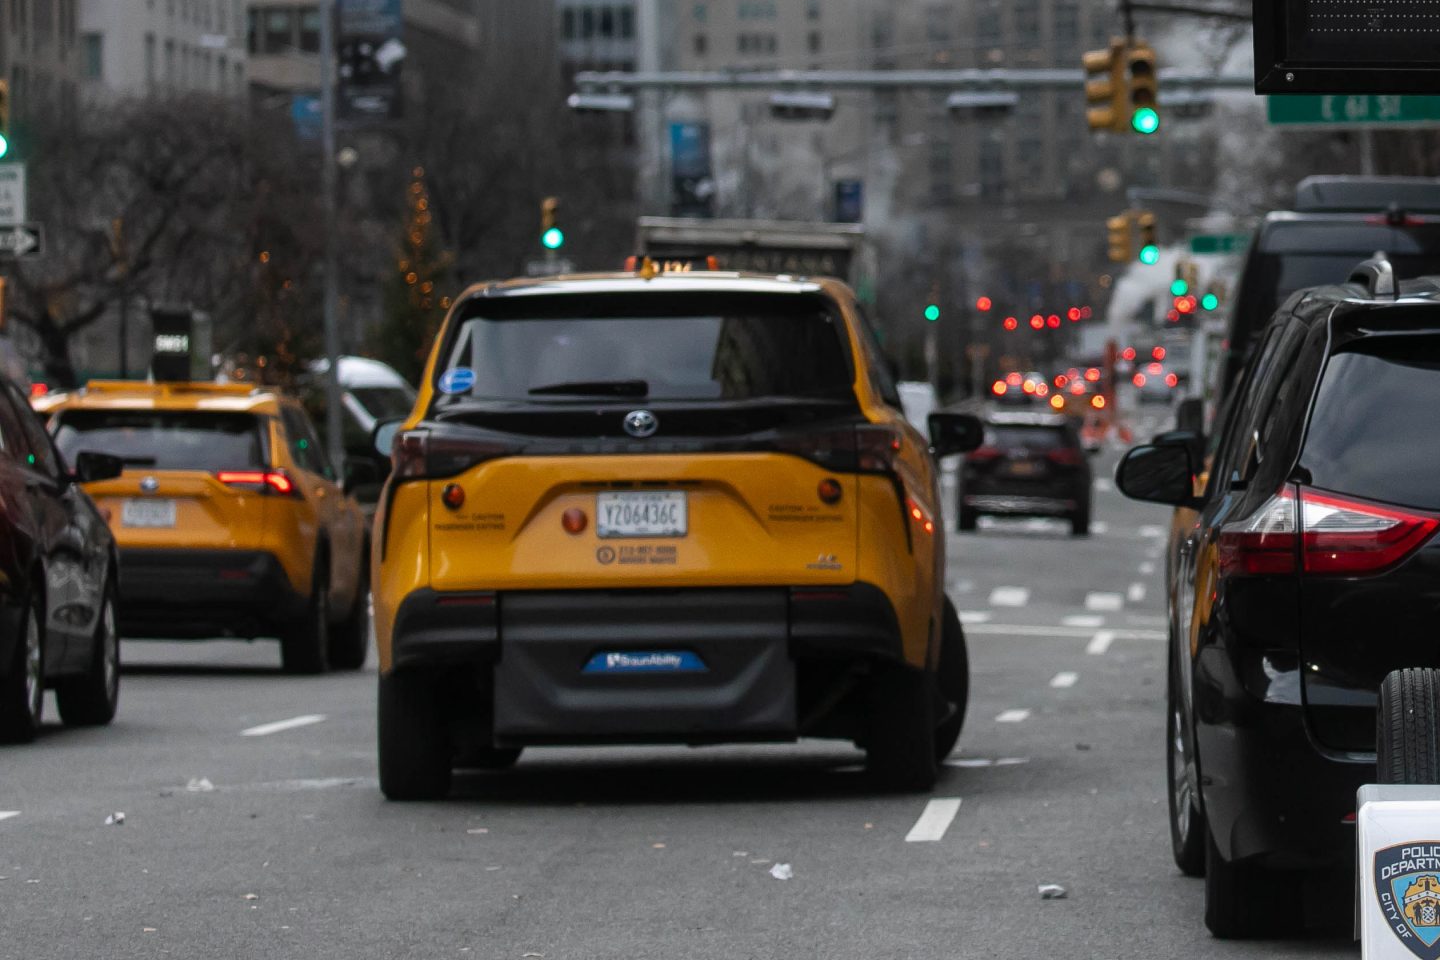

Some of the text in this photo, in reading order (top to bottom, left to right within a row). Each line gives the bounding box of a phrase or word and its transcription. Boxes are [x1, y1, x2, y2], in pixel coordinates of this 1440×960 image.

[604, 503, 677, 525] Y206436C
[1381, 892, 1413, 938] CITY OF
